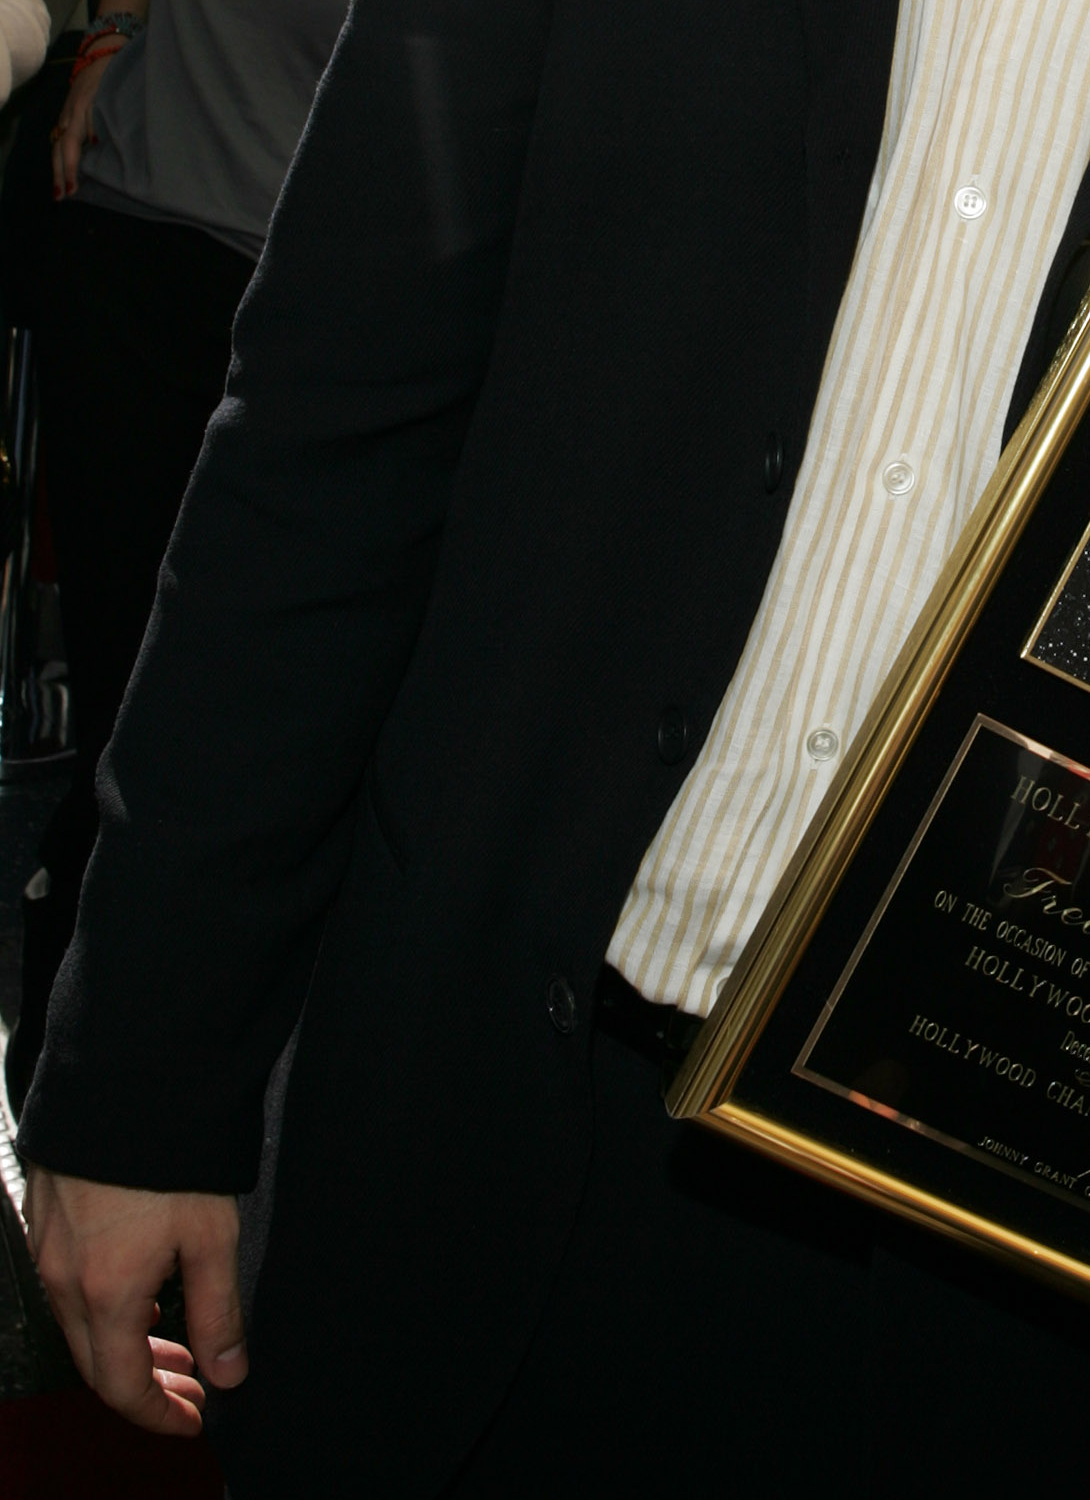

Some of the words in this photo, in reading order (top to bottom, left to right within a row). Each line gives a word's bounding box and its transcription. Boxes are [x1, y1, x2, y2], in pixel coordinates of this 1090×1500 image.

[934, 890, 958, 914] ON
[961, 903, 992, 931] THE
[996, 921, 1067, 967] OCCASION
[909, 1015, 1036, 1088] HOLLYWOOD
[977, 1135, 1029, 1166] JOHNNY
[1034, 1162, 1078, 1189] GRANT
